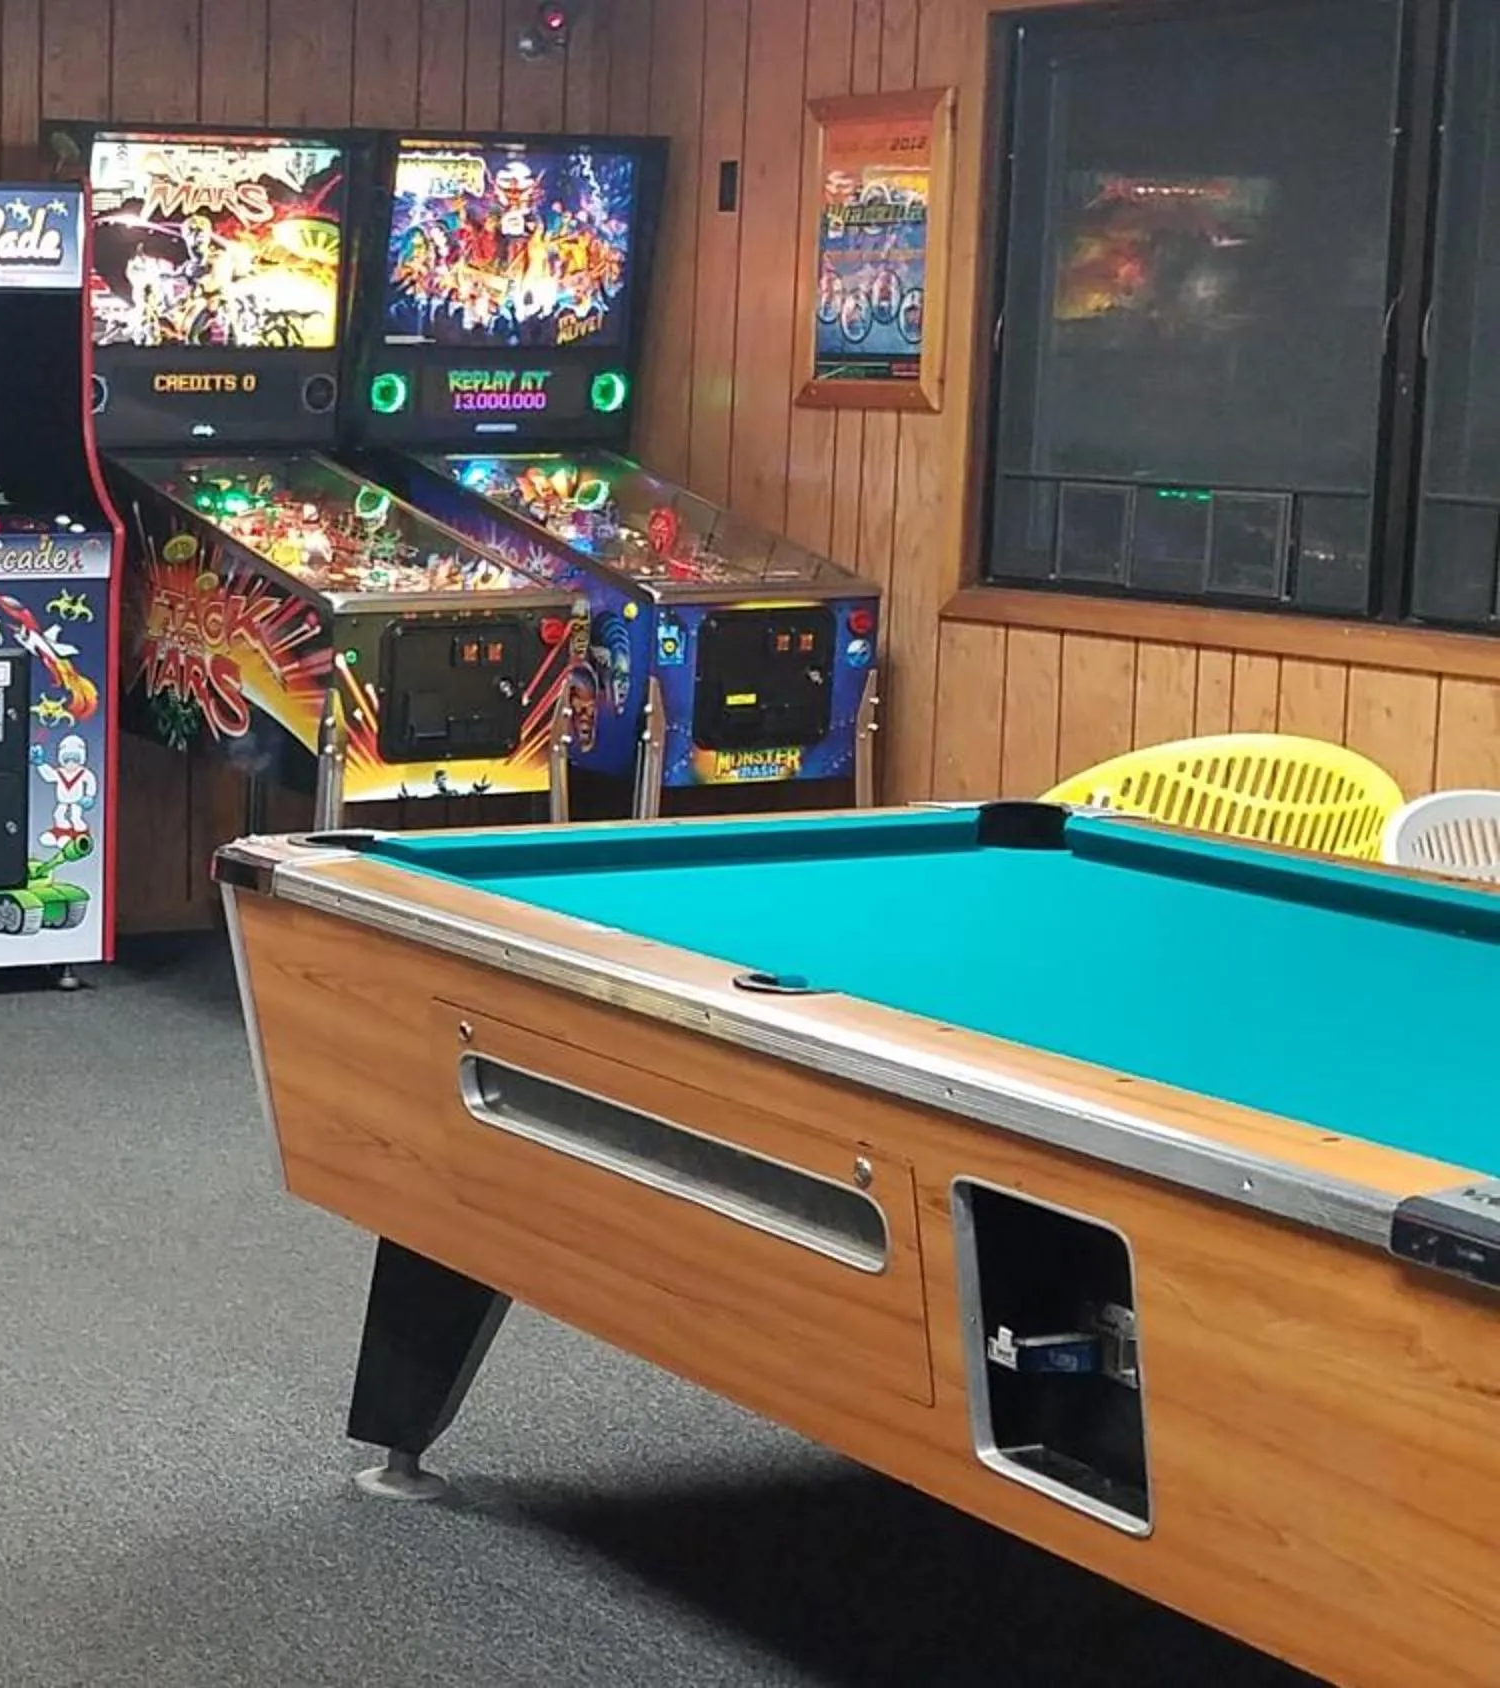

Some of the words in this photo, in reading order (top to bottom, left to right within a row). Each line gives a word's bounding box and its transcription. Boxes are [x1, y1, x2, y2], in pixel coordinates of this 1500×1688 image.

[140, 181, 275, 231] MARS
[153, 373, 237, 392] CREDITS
[242, 374, 257, 392] 0
[448, 369, 516, 392] REPLAY
[520, 369, 553, 391] AT
